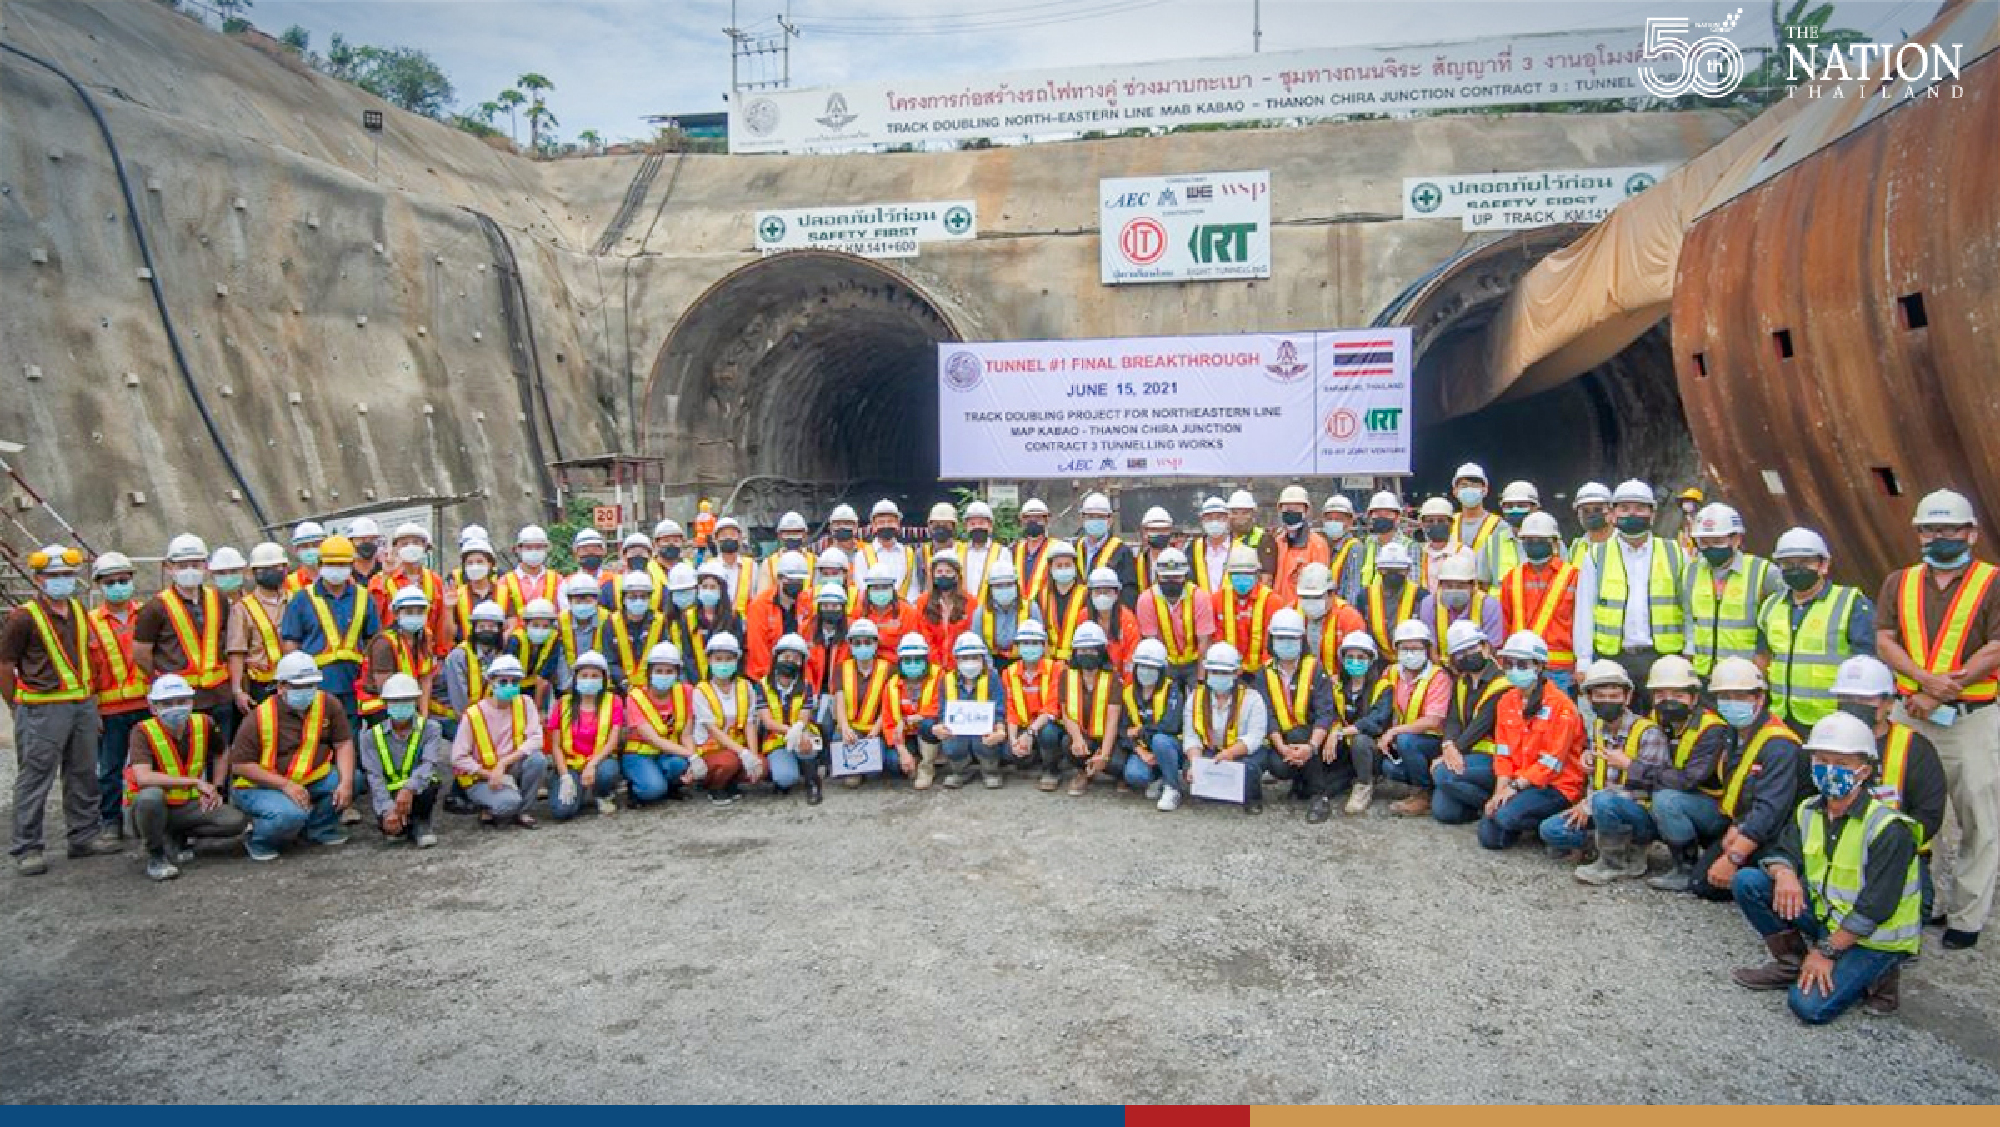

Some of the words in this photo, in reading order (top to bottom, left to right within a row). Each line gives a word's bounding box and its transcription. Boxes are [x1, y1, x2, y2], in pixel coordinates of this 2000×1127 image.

[886, 79, 1118, 112] โครงการก่อสร้างรถไฟทางคู่
[1123, 75, 1252, 98] ช่วงมาบกะเบา
[1433, 44, 1513, 81] สัญญาที่
[1521, 56, 1533, 71] 3
[887, 122, 928, 133] TRACK
[932, 117, 999, 132] DOUBLING
[1004, 109, 1119, 127] NORTH-EASTERN
[1124, 106, 1154, 119] LINE
[1161, 104, 1191, 116] MAB
[1196, 101, 1245, 114] KABAO
[1265, 95, 1325, 108] THANON
[1330, 92, 1375, 106] CHIRA
[1380, 88, 1456, 103] JUNCTION
[1461, 82, 1543, 98] CONTRACT
[1549, 82, 1559, 93] 3
[1574, 77, 1636, 91] TUNNEL
[1448, 173, 1612, 195] ปลอดภัยไว้ก่อน
[1466, 198, 1537, 209] SAFETY
[798, 207, 936, 228] ปลอดภัยไว้ก่อน
[1471, 212, 1493, 226] UP
[1503, 210, 1555, 224] TRACK
[807, 230, 867, 242] SAFETY
[875, 226, 918, 238] FIRST
[985, 359, 1046, 373] TUNNEL
[1049, 357, 1067, 372] #1
[1072, 355, 1118, 371] FINAL
[1121, 352, 1261, 370] BREAKTHROUGH
[1066, 382, 1108, 397] JUNE
[1117, 382, 1138, 397] 15,
[1142, 381, 1178, 396] 2021
[964, 411, 1003, 422] TRACK
[1005, 410, 1065, 422] DOUBLING
[1067, 409, 1121, 421] PROJECT
[1124, 408, 1149, 420] FOR
[1152, 406, 1251, 420] NORTHEASTERN
[1254, 406, 1282, 418] LINE
[1011, 426, 1036, 437] MAP
[1038, 426, 1079, 436] KABAO
[1090, 424, 1138, 436] THANON
[1141, 424, 1179, 434] CHIRA
[1182, 422, 1243, 434] JUNCTION
[1024, 441, 1089, 452] CONTRACT
[1091, 441, 1099, 451] 3
[1101, 439, 1177, 451] TUNNELLING
[1180, 438, 1224, 450] WORKS
[597, 508, 614, 523] 20
